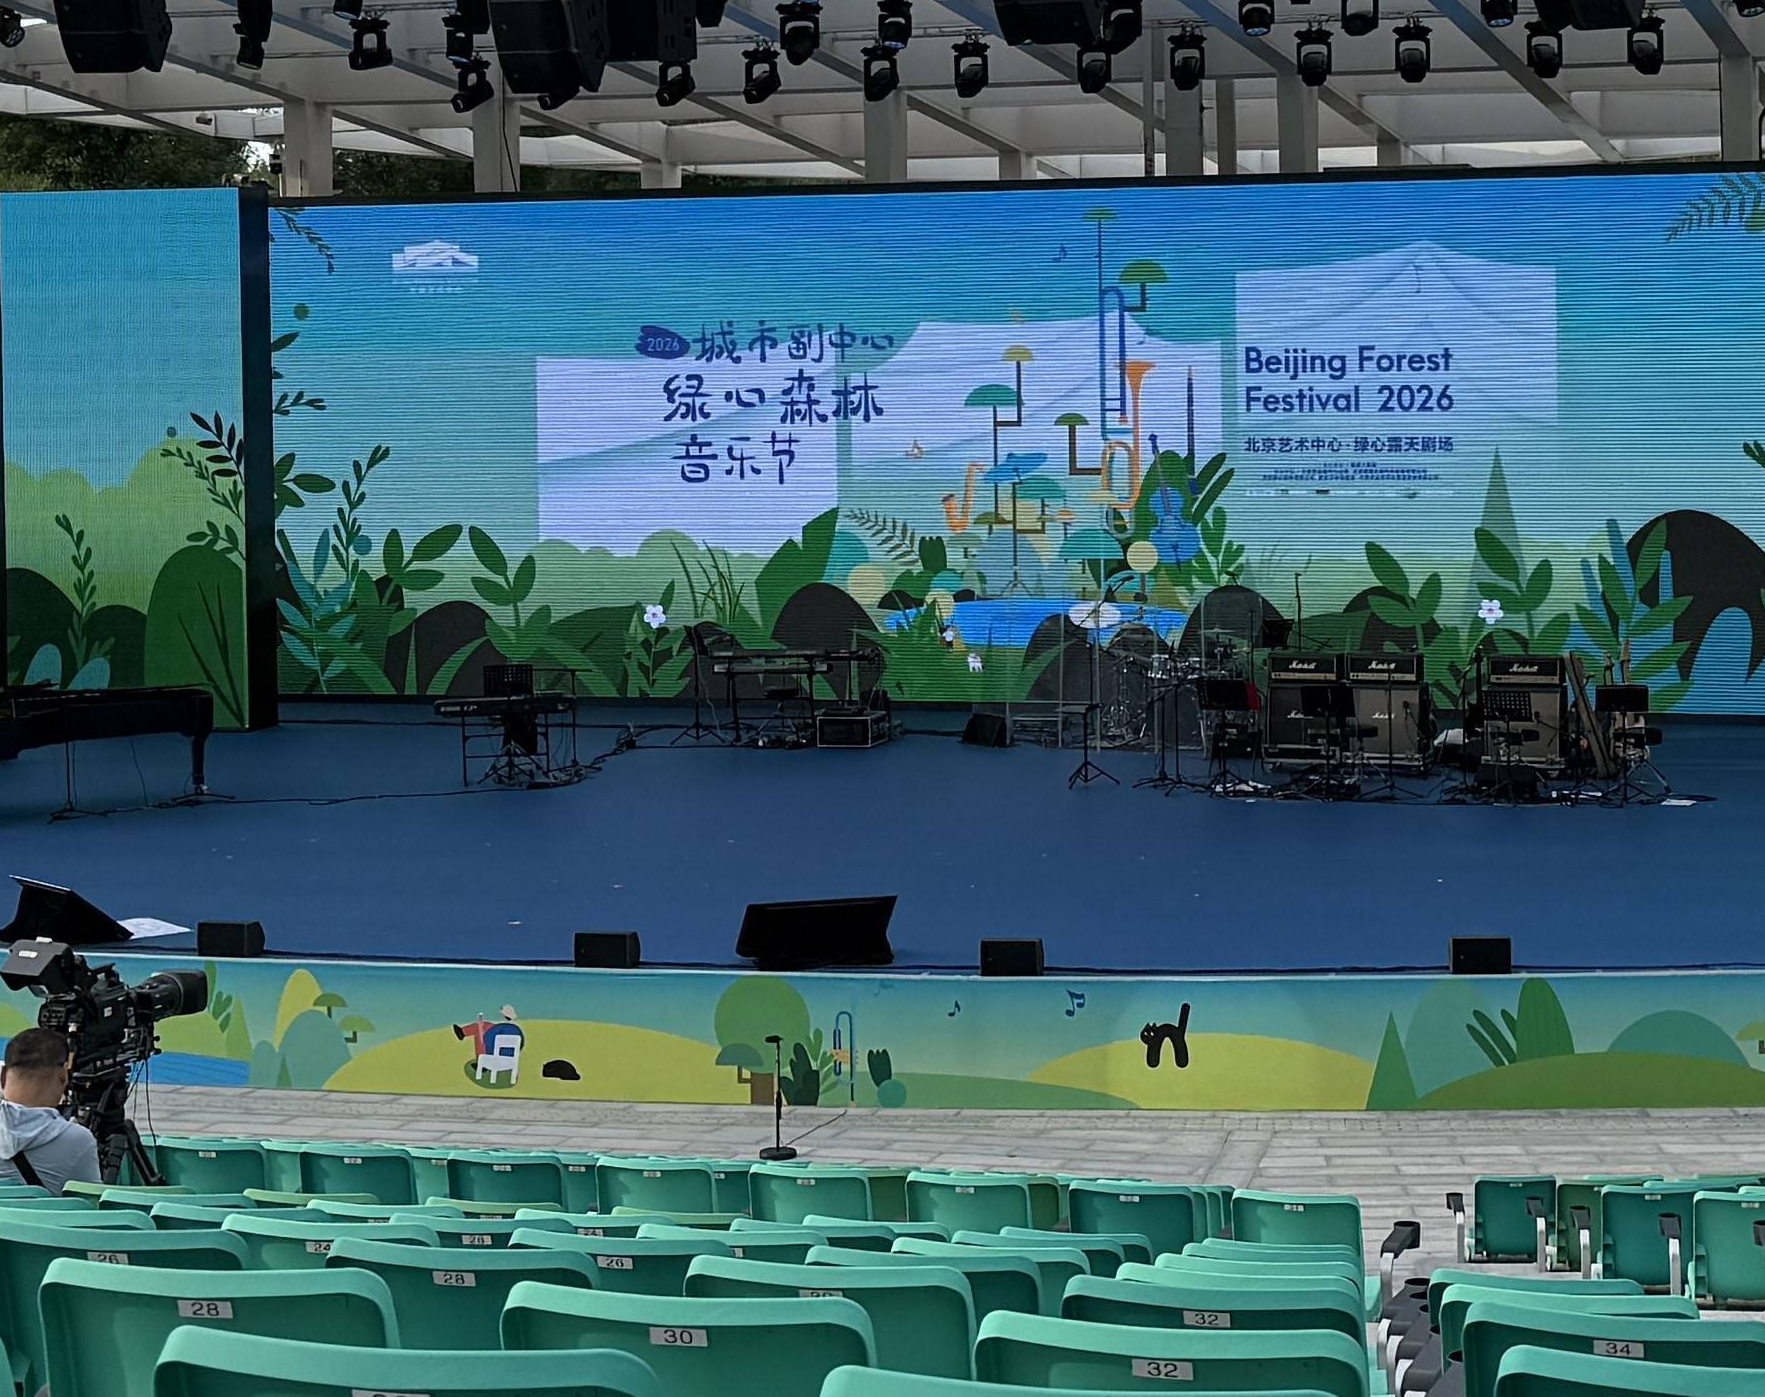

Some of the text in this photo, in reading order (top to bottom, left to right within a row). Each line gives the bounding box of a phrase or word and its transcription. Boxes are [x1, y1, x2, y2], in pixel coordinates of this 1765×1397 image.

[647, 320, 895, 364] 2026 城市副中心
[1244, 345, 1454, 381] Beijing Forest
[663, 368, 885, 428] 绿心森林
[1245, 384, 1455, 413] Festival 2026
[669, 430, 802, 486] 音乐节
[191, 1302, 220, 1317] 28
[1194, 1312, 1219, 1326] 32
[663, 1329, 693, 1345] 30
[1605, 1341, 1631, 1356] 34
[1147, 1361, 1179, 1378] 32
